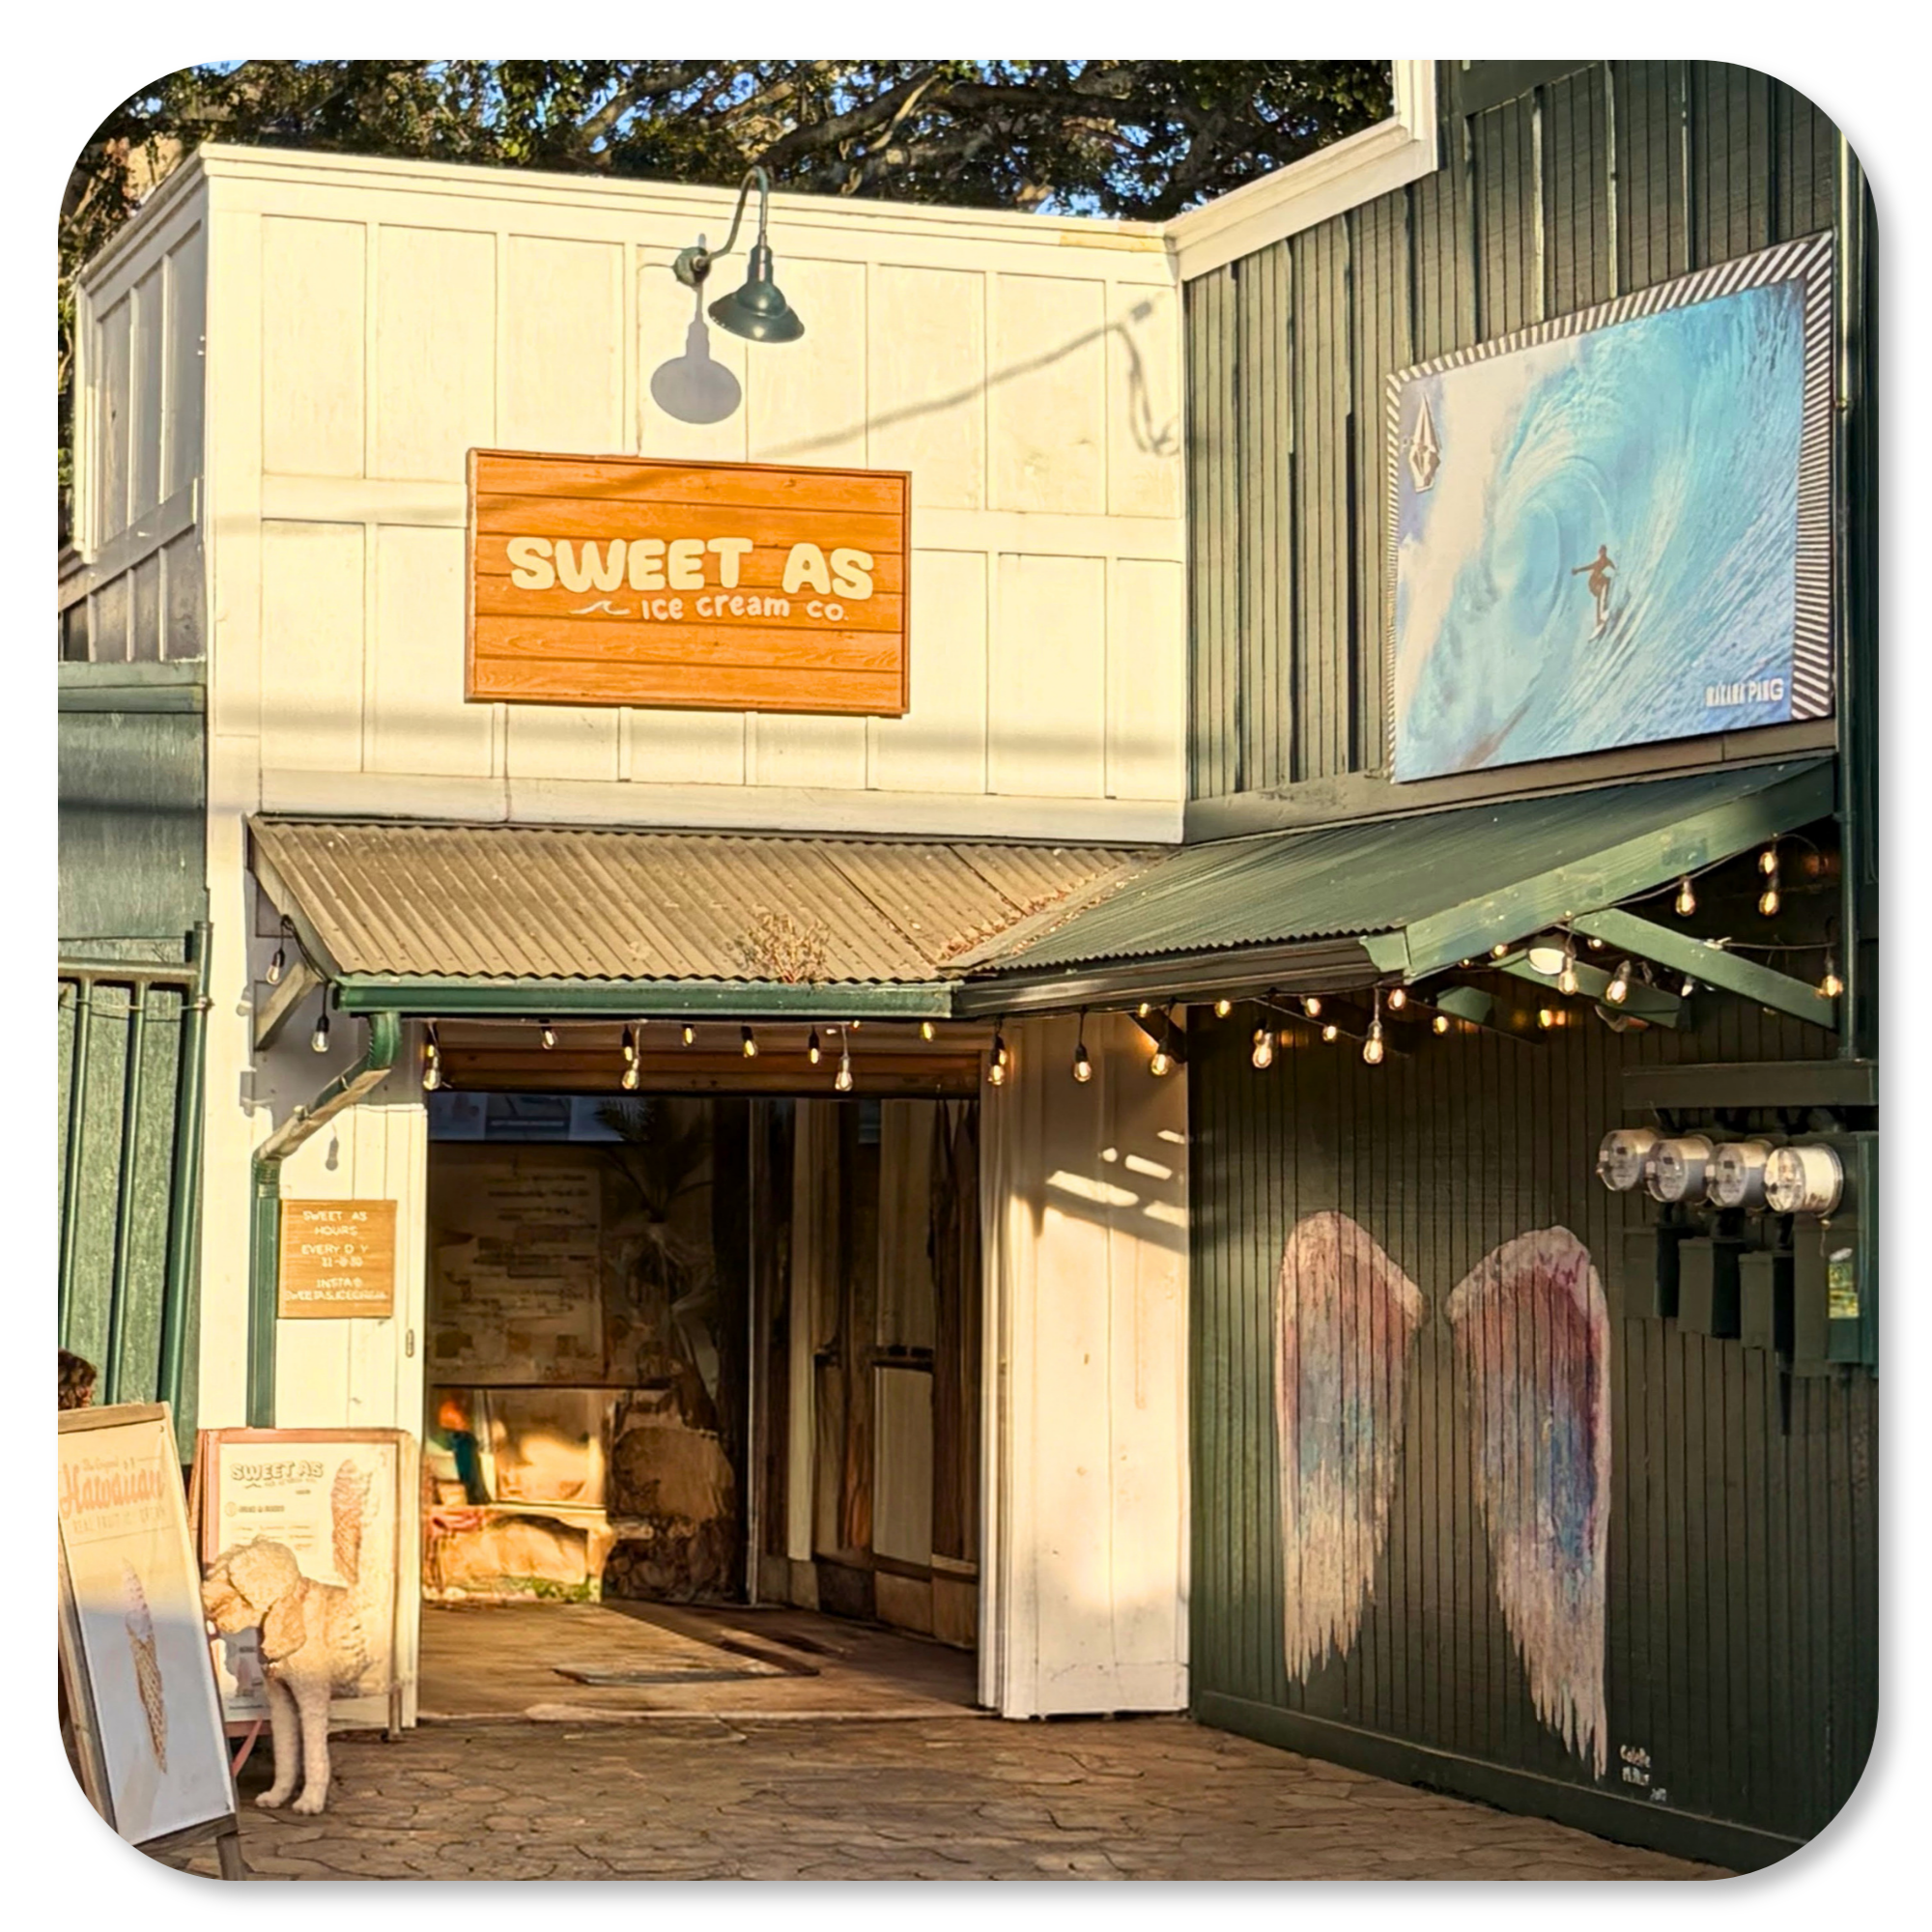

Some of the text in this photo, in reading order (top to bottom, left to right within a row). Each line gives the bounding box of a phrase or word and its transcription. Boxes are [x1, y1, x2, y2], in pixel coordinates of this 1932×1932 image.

[505, 536, 875, 601] SWEET AS
[696, 593, 791, 618] cream
[302, 1210, 368, 1222] SWEET AS
[315, 1226, 358, 1236] HOURS
[301, 1244, 341, 1256] EVERY
[230, 1460, 324, 1482] SWEET AS
[59, 1457, 165, 1520] Hawaiian
